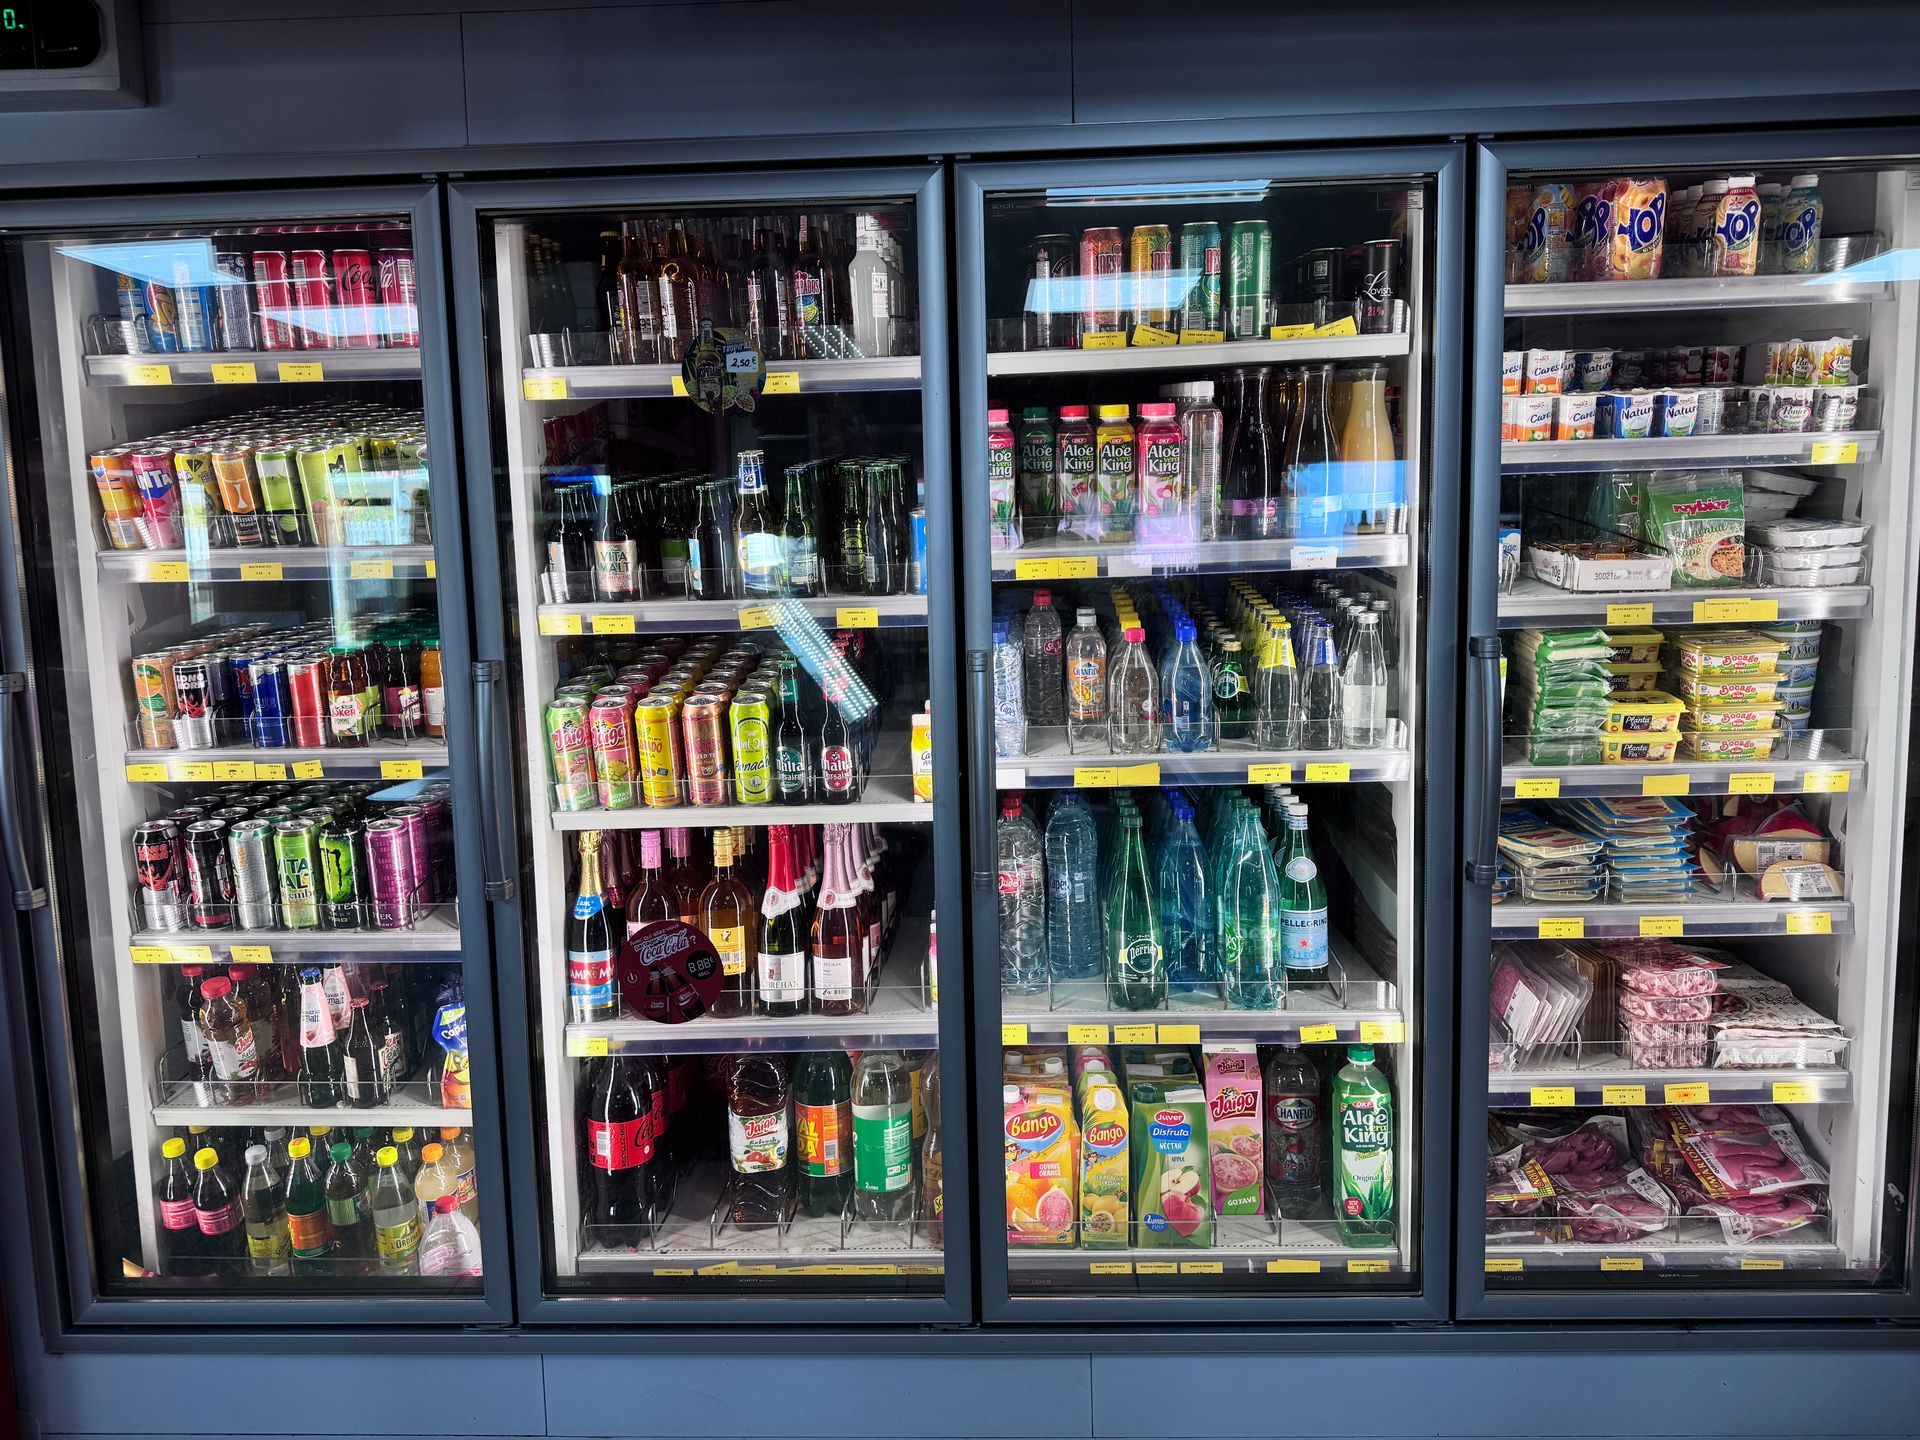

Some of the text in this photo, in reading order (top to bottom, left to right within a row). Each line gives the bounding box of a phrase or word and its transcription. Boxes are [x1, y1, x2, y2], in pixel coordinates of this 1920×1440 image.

[1617, 191, 1666, 252] YOP
[1716, 199, 1761, 248] YOP
[989, 448, 1012, 462] loe
[1022, 444, 1053, 457] Aloe
[1064, 444, 1094, 457] Aloe
[1101, 444, 1132, 457] Aloe
[1148, 445, 1180, 458] Aloe
[989, 464, 1012, 477] ing
[1023, 457, 1053, 471] King
[1065, 457, 1094, 471] King
[1102, 458, 1132, 472] King
[1149, 459, 1180, 473] King
[600, 552, 627, 562] VITA
[1722, 654, 1760, 666] Bocage
[1719, 683, 1757, 697] Bocage
[1625, 715, 1650, 724] Planta
[1721, 712, 1757, 724] Bocage
[1623, 743, 1648, 752] Planta
[1719, 739, 1757, 752] Bocage
[1130, 943, 1157, 966] Perrier
[1212, 1092, 1255, 1118] Jaigo
[1156, 1112, 1183, 1121] Juver
[1343, 1110, 1387, 1125] Aloe
[1152, 1127, 1190, 1137] Disfruta
[1344, 1127, 1388, 1148] King
[1038, 1169, 1062, 1177] ORANGE
[1352, 1174, 1380, 1183] Original
[1227, 1195, 1257, 1206] GOYAVE
